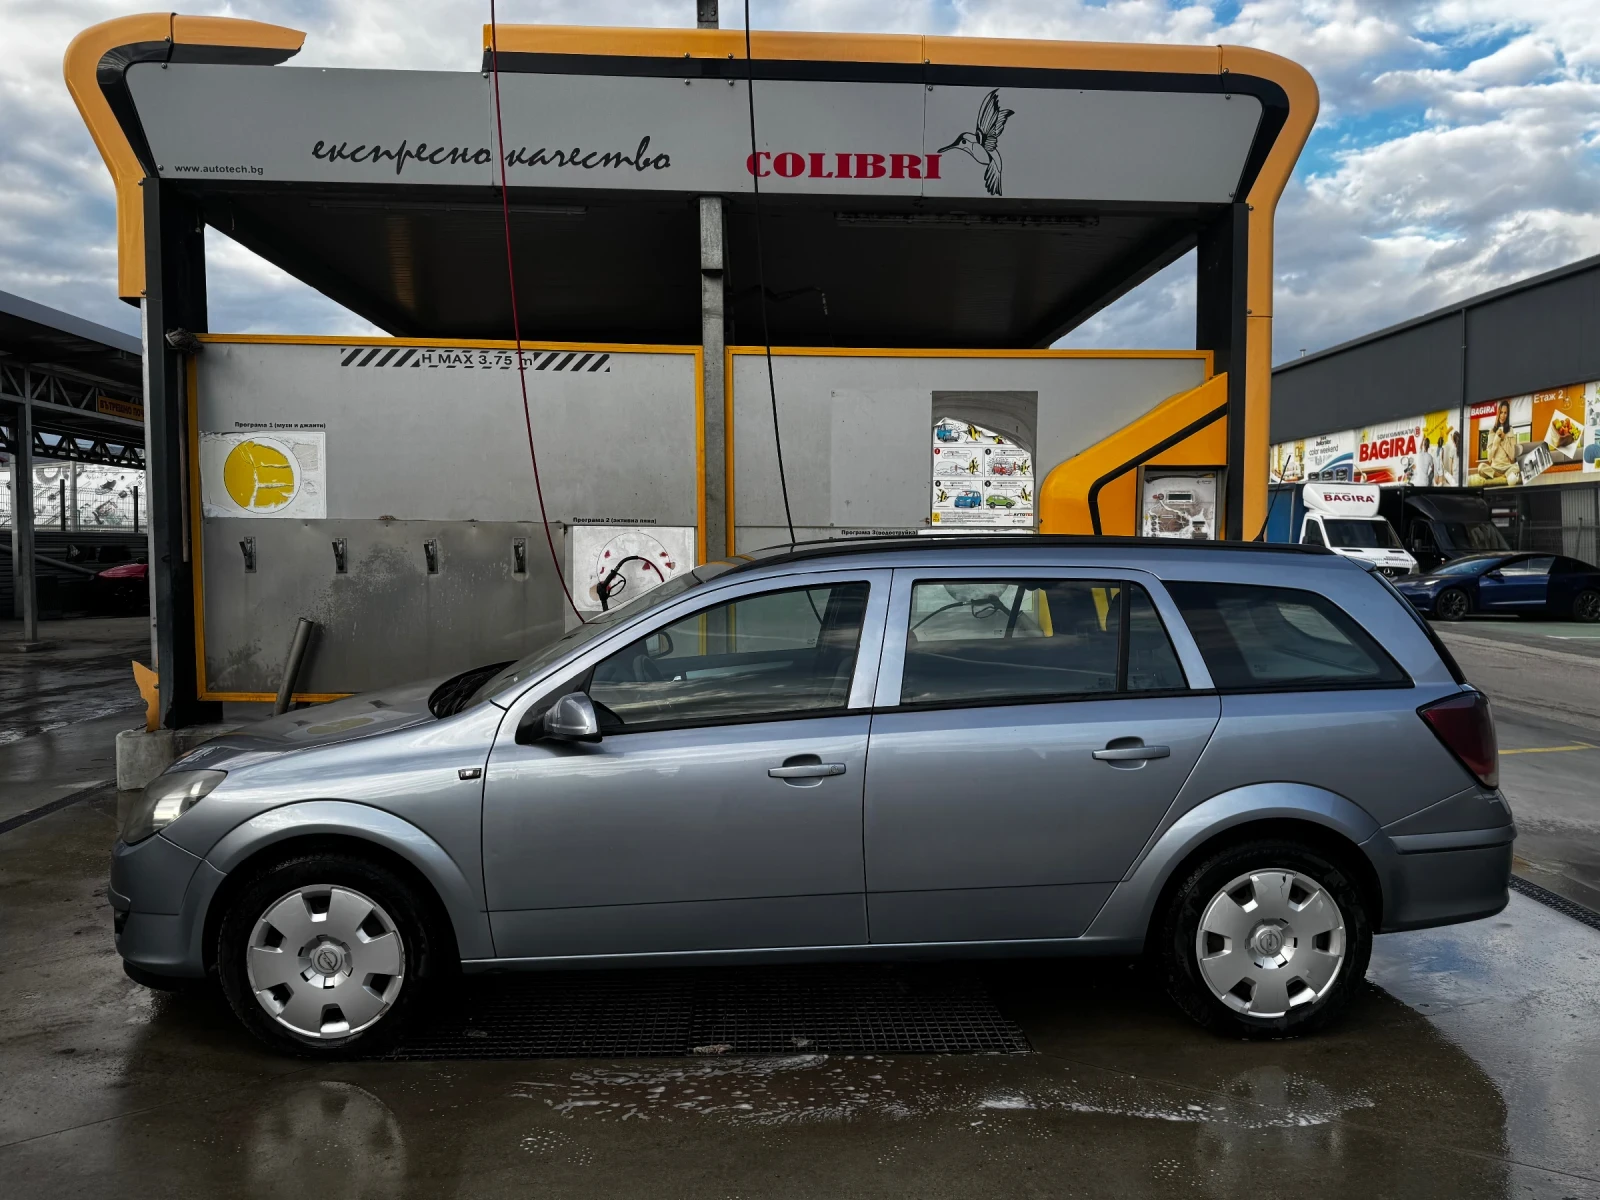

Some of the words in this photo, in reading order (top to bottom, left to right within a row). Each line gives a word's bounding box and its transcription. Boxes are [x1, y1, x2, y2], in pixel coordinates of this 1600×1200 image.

[311, 139, 492, 175] експресно
[504, 135, 671, 172] качество
[174, 165, 264, 176] www.autotech.bg
[746, 151, 942, 179] COLIBRI
[421, 353, 432, 364] H
[438, 353, 474, 365] MAX
[478, 354, 513, 366] 3.75
[1533, 393, 1557, 404] Етаж
[1557, 389, 1564, 399] 2
[1470, 405, 1496, 416] BAGIRA
[234, 421, 268, 429] Програма
[1359, 435, 1417, 462] BAGIRA
[1324, 494, 1375, 503] BAGIRA
[573, 516, 604, 524] Програма
[841, 529, 871, 537] Програма
